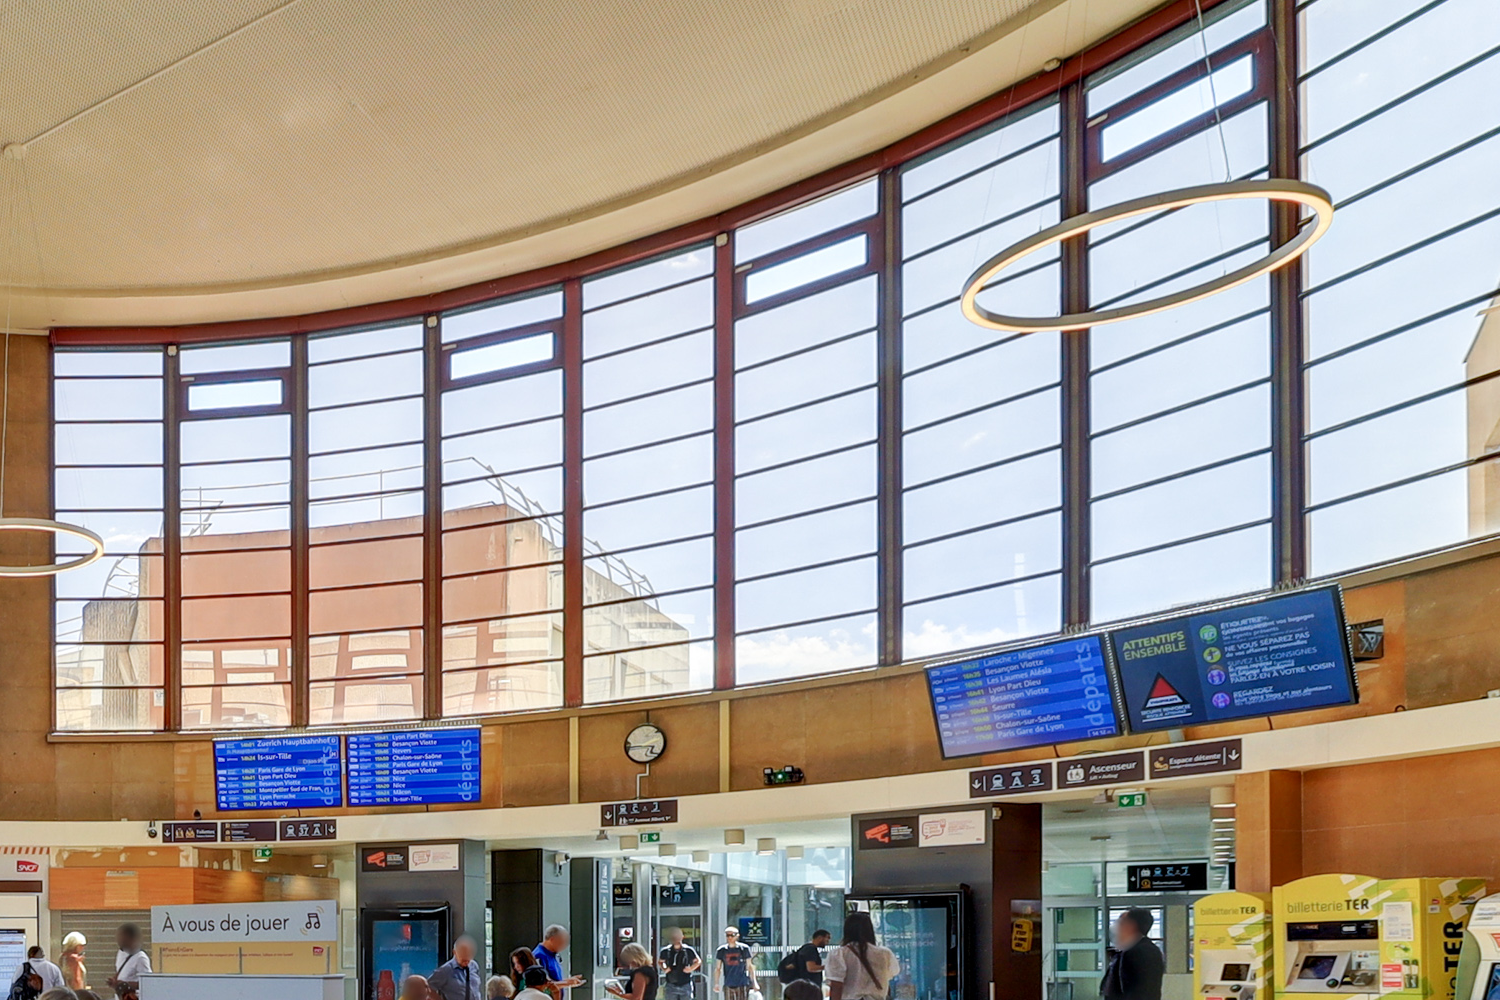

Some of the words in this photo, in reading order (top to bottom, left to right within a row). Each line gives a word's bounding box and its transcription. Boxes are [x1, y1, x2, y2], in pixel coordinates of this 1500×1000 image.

[1123, 631, 1184, 651] ATTENTIFS
[1238, 642, 1258, 650] VOUS
[1260, 635, 1293, 646] SÉPAREZ
[1295, 631, 1310, 639] PAS
[984, 656, 1011, 666] Laroche
[1018, 648, 1054, 661] Migennes
[1124, 641, 1187, 661] ENSEMBLE
[1270, 646, 1317, 660] CONSIGNES
[985, 663, 1019, 676] Besançon
[1020, 659, 1044, 669] Viotte
[1281, 666, 1307, 676] VOTRE
[1308, 661, 1335, 672] VOISIN
[987, 677, 999, 685] Les
[1000, 672, 1028, 683] Laumes
[1030, 667, 1052, 677] Alésia
[989, 684, 1005, 694] Lyon
[1007, 681, 1023, 691] Part
[1024, 679, 1041, 688] Dieu
[1076, 642, 1104, 726] départs
[990, 691, 1024, 703] Besançon
[1026, 687, 1049, 697] Viotte
[992, 702, 1016, 712] Seurre
[994, 709, 1032, 720] Is-sur-Tille
[996, 714, 1061, 730] Chalon-sur-Saône
[998, 730, 1015, 738] Paris
[1016, 727, 1034, 736] Gare
[1035, 725, 1045, 733] de
[1046, 723, 1064, 732] Lyon
[392, 753, 442, 761] Chalon-sur-Saône
[1169, 757, 1192, 766] Espace
[1194, 752, 1221, 762] détente
[458, 739, 475, 801] départs
[1089, 761, 1137, 774] Ascenseur
[321, 746, 337, 805] départs
[1012, 776, 1022, 787] A
[1032, 774, 1041, 784] 3
[299, 827, 309, 835] 37
[314, 827, 320, 835] A
[18, 864, 38, 872] SNCF
[1200, 908, 1239, 916] billetterie
[1287, 900, 1342, 913] billetterie
[1345, 899, 1369, 910] TER
[162, 912, 174, 932] À
[179, 919, 215, 932] vous
[220, 914, 241, 931] de
[245, 914, 289, 936] jouer
[1444, 921, 1464, 972] TER
